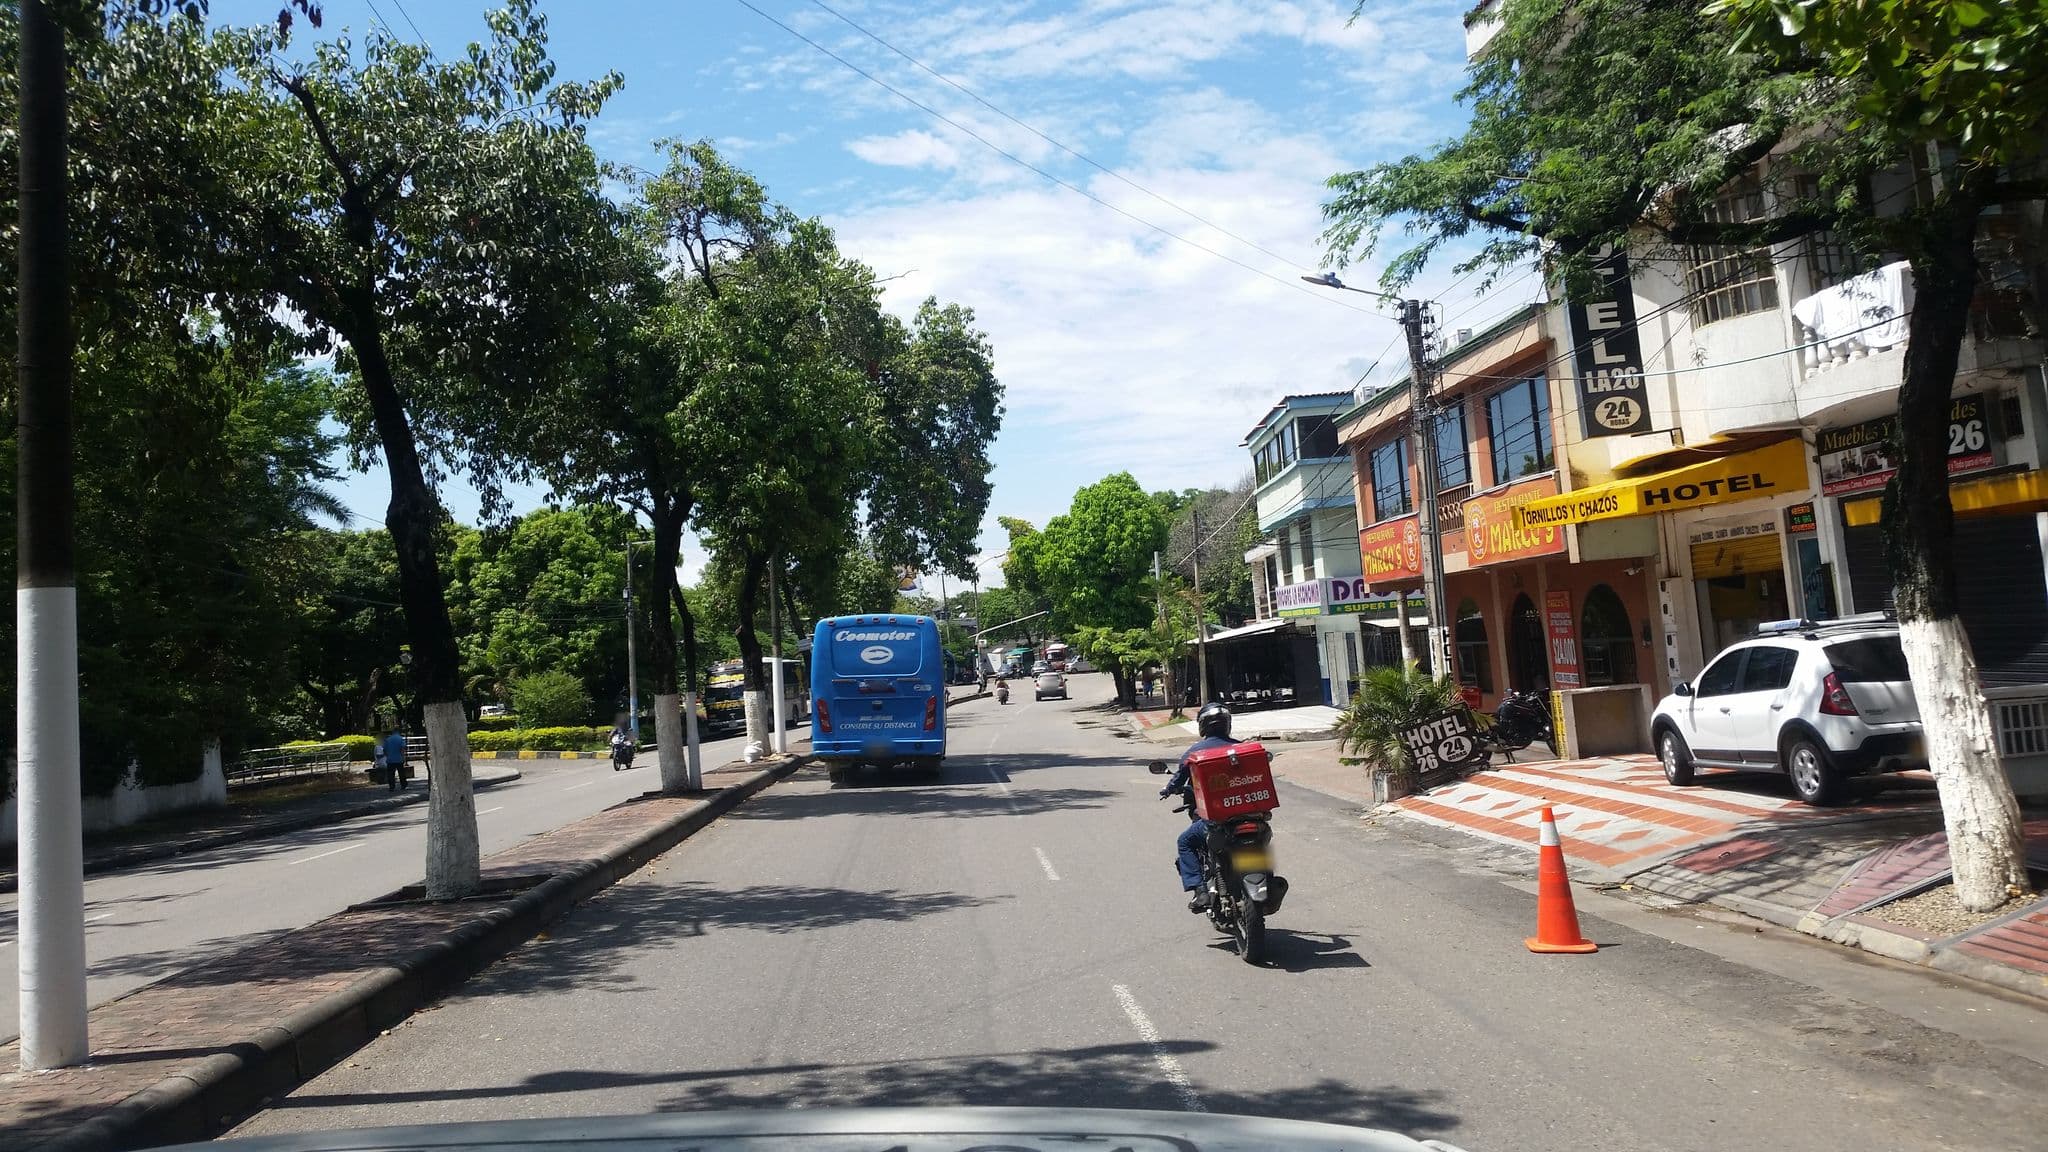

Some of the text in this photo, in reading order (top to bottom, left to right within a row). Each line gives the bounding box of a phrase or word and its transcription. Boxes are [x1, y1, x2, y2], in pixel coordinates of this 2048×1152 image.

[1603, 400, 1632, 420] 24
[1823, 424, 1879, 451] Muebles
[1947, 419, 1985, 455] 26
[1642, 473, 1775, 507] HOTEL
[1520, 495, 1619, 527] TORNILLOS Y CHAZOS
[1344, 602, 1386, 613] SUPER
[835, 630, 916, 642] Coomotor
[883, 721, 917, 729] DISTANCIA
[1406, 714, 1467, 750] HOTEL
[1413, 745, 1434, 758] LA
[1443, 738, 1465, 756] 24
[1416, 754, 1439, 774] 26
[1223, 789, 1270, 808] 875 3388
